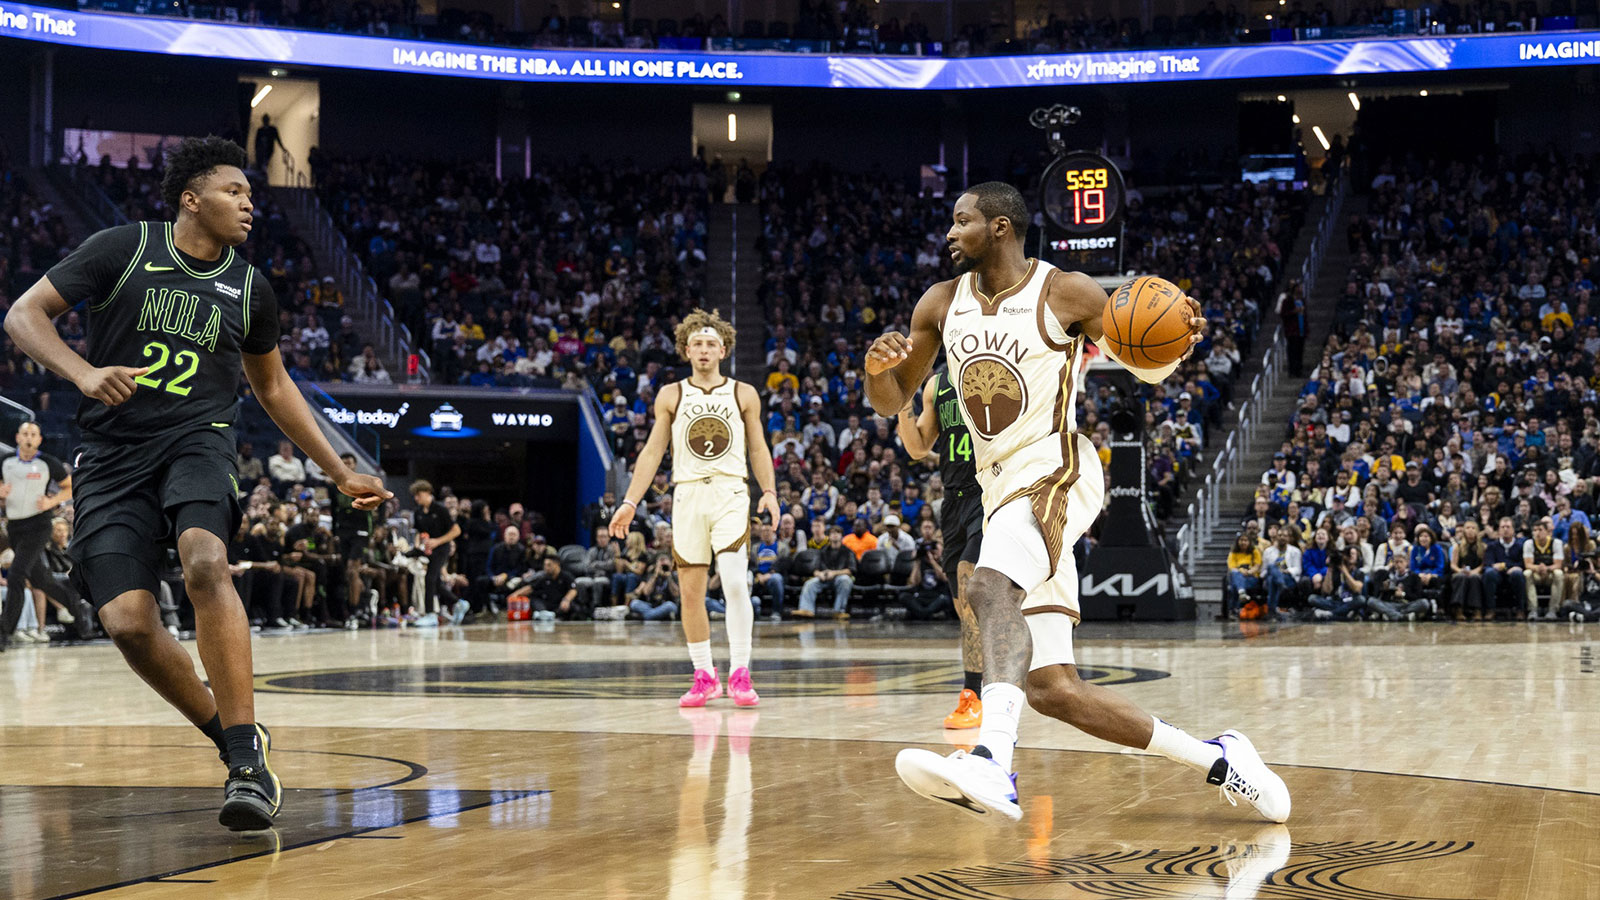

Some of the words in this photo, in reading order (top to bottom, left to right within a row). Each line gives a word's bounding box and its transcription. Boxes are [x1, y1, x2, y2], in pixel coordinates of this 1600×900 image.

[32, 12, 76, 36] That
[393, 47, 477, 71] IMAGINE
[480, 55, 517, 73] THE
[520, 58, 567, 75] NBA.
[570, 60, 606, 76] ALL
[609, 60, 630, 76] IN
[632, 61, 674, 78] ONE
[677, 62, 743, 79] PLACE.
[1027, 59, 1083, 80] xfinity
[1087, 57, 1156, 78] Imagine
[1159, 56, 1200, 73] That
[1066, 168, 1108, 190] 5:59
[1073, 189, 1105, 224] 19
[137, 288, 221, 352] NOLA
[1003, 306, 1033, 315] Rakuten
[949, 330, 1029, 364] TOWN
[135, 341, 199, 396] 22
[357, 408, 400, 428] today
[492, 413, 553, 427] WAYMO
[682, 403, 733, 420] TOWN
[704, 440, 714, 456] 2
[949, 433, 972, 461] 14
